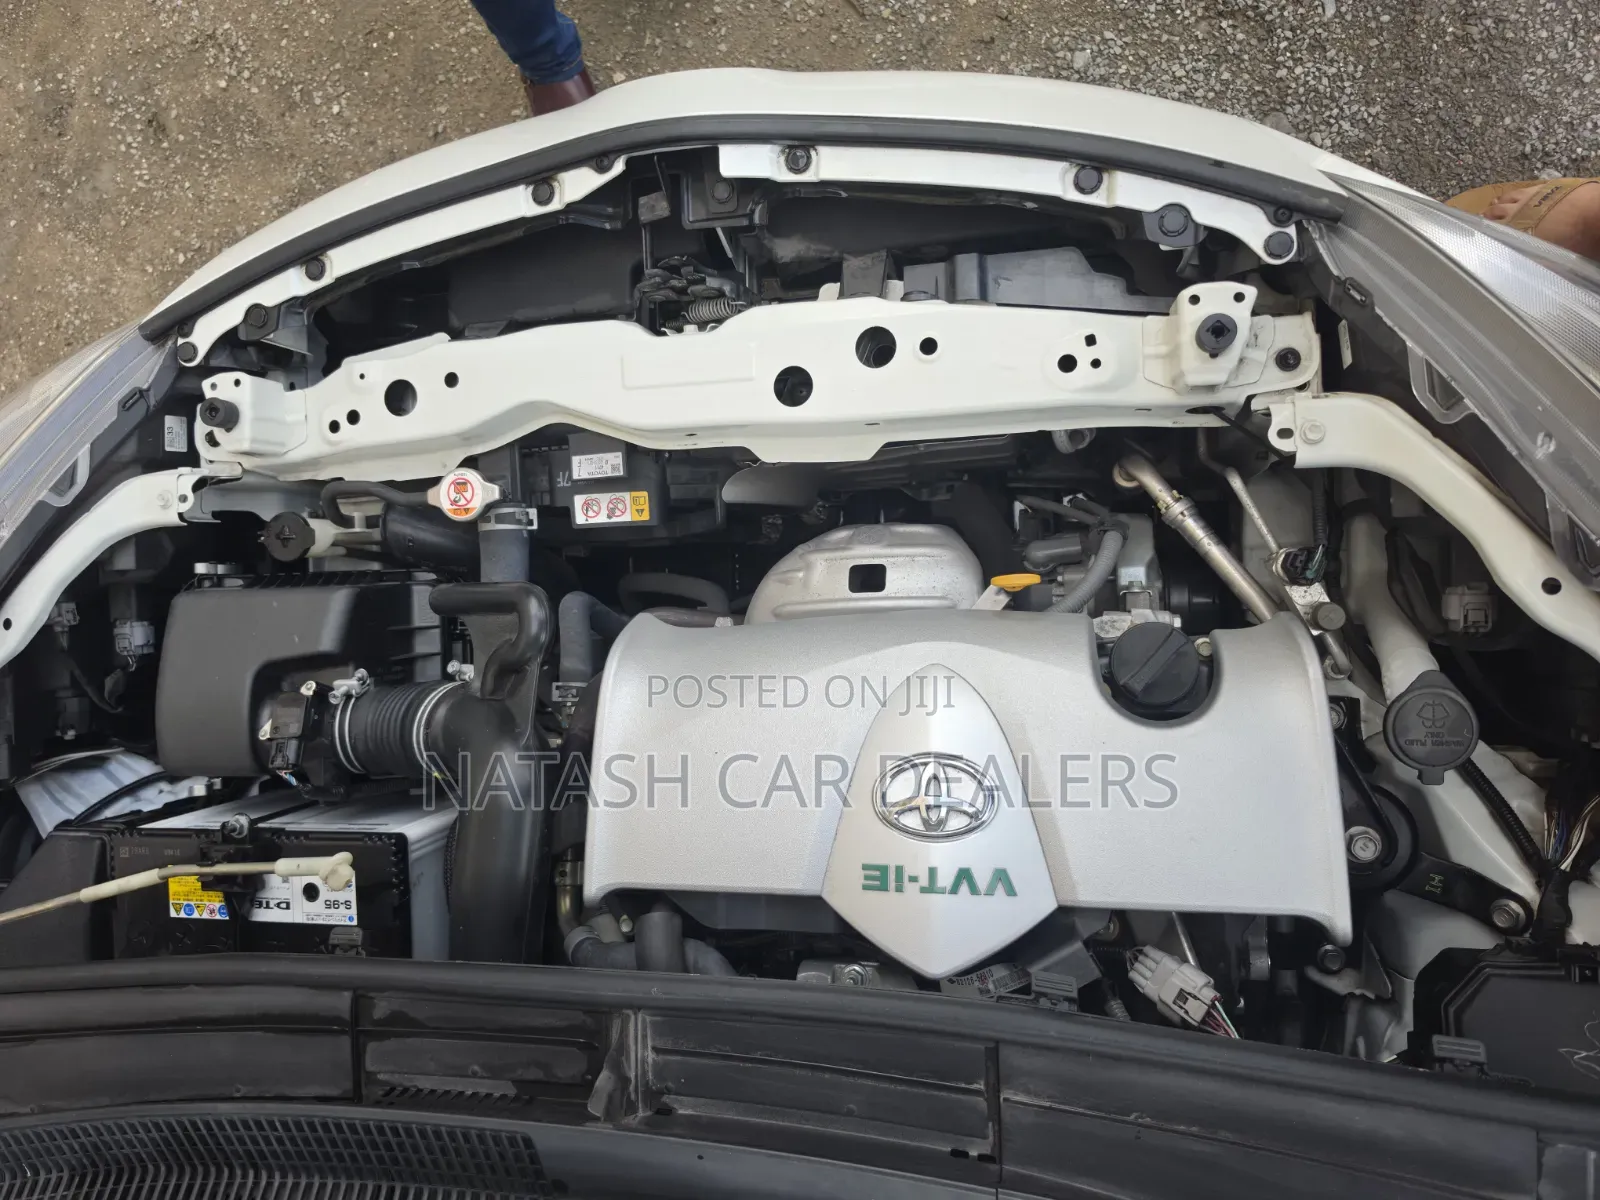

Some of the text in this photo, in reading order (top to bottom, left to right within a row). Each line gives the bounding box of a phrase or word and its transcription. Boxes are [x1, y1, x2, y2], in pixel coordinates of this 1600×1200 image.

[1423, 731, 1446, 739] ONLY
[1431, 739, 1465, 747] WASHER
[324, 899, 353, 911] S-95
